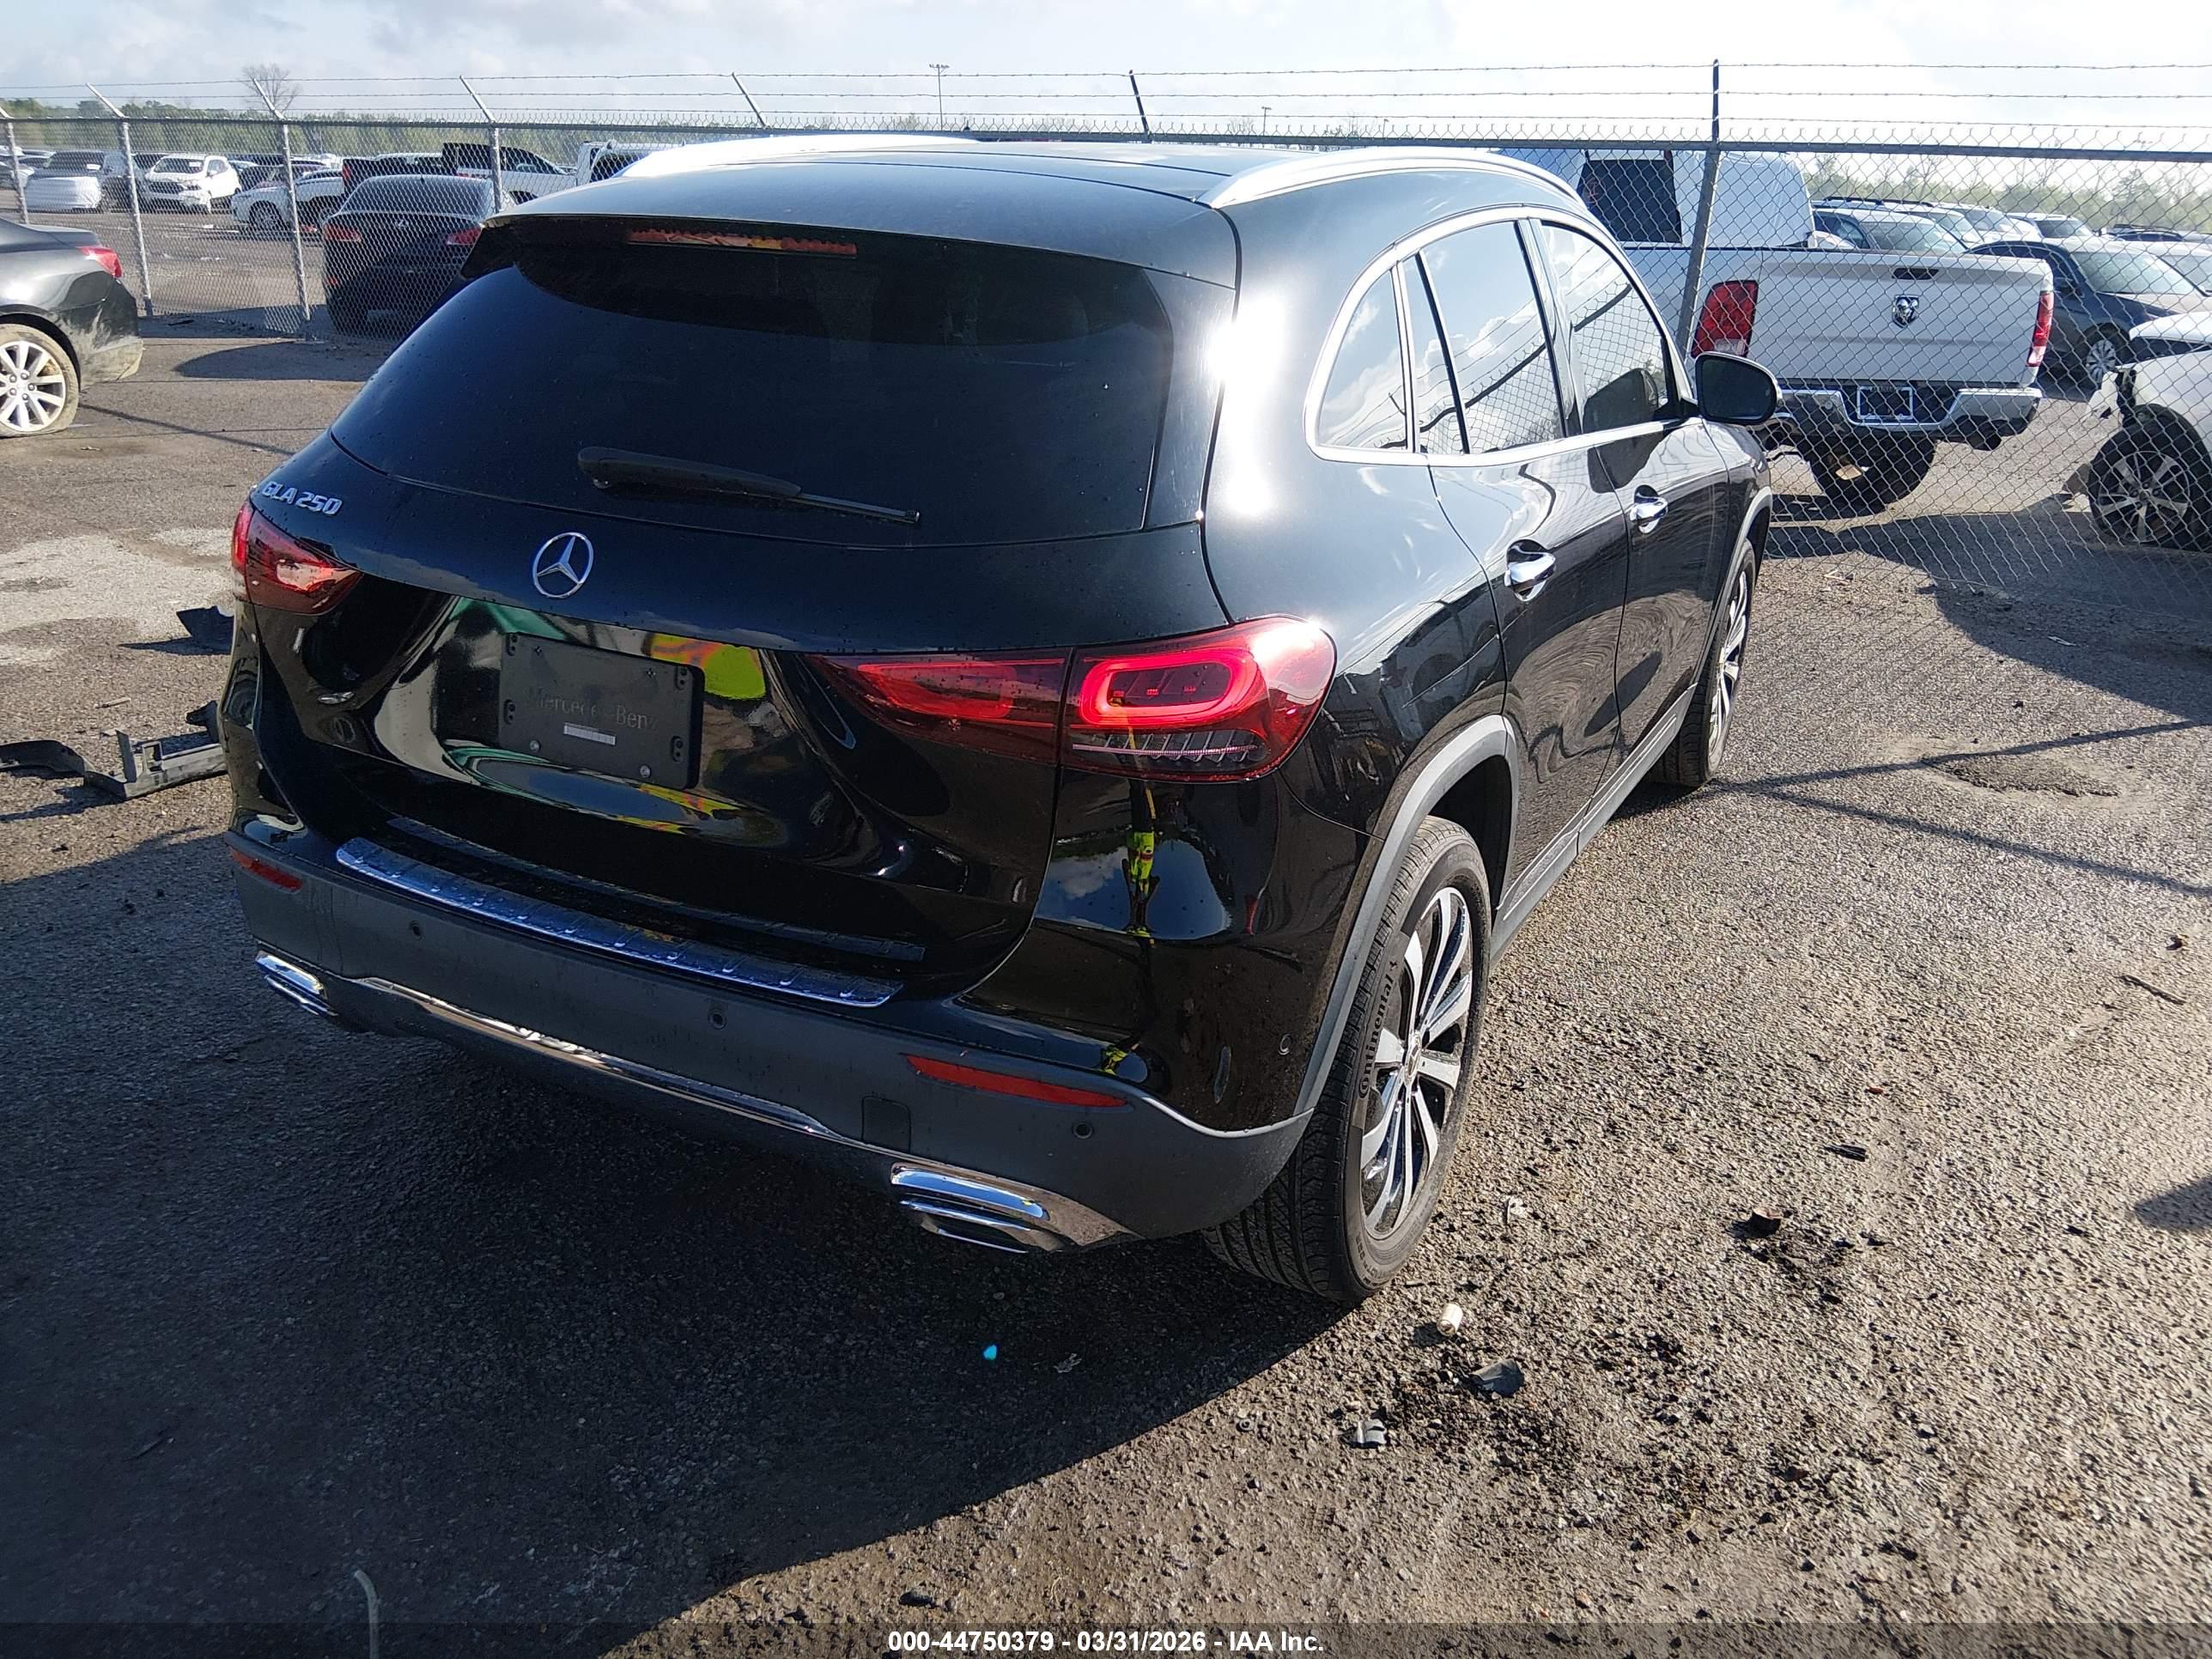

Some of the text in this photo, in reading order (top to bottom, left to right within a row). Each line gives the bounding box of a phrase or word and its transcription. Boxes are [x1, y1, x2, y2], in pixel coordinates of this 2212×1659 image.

[261, 480, 344, 515] GLA 250
[1357, 973, 1395, 1100] Continental
